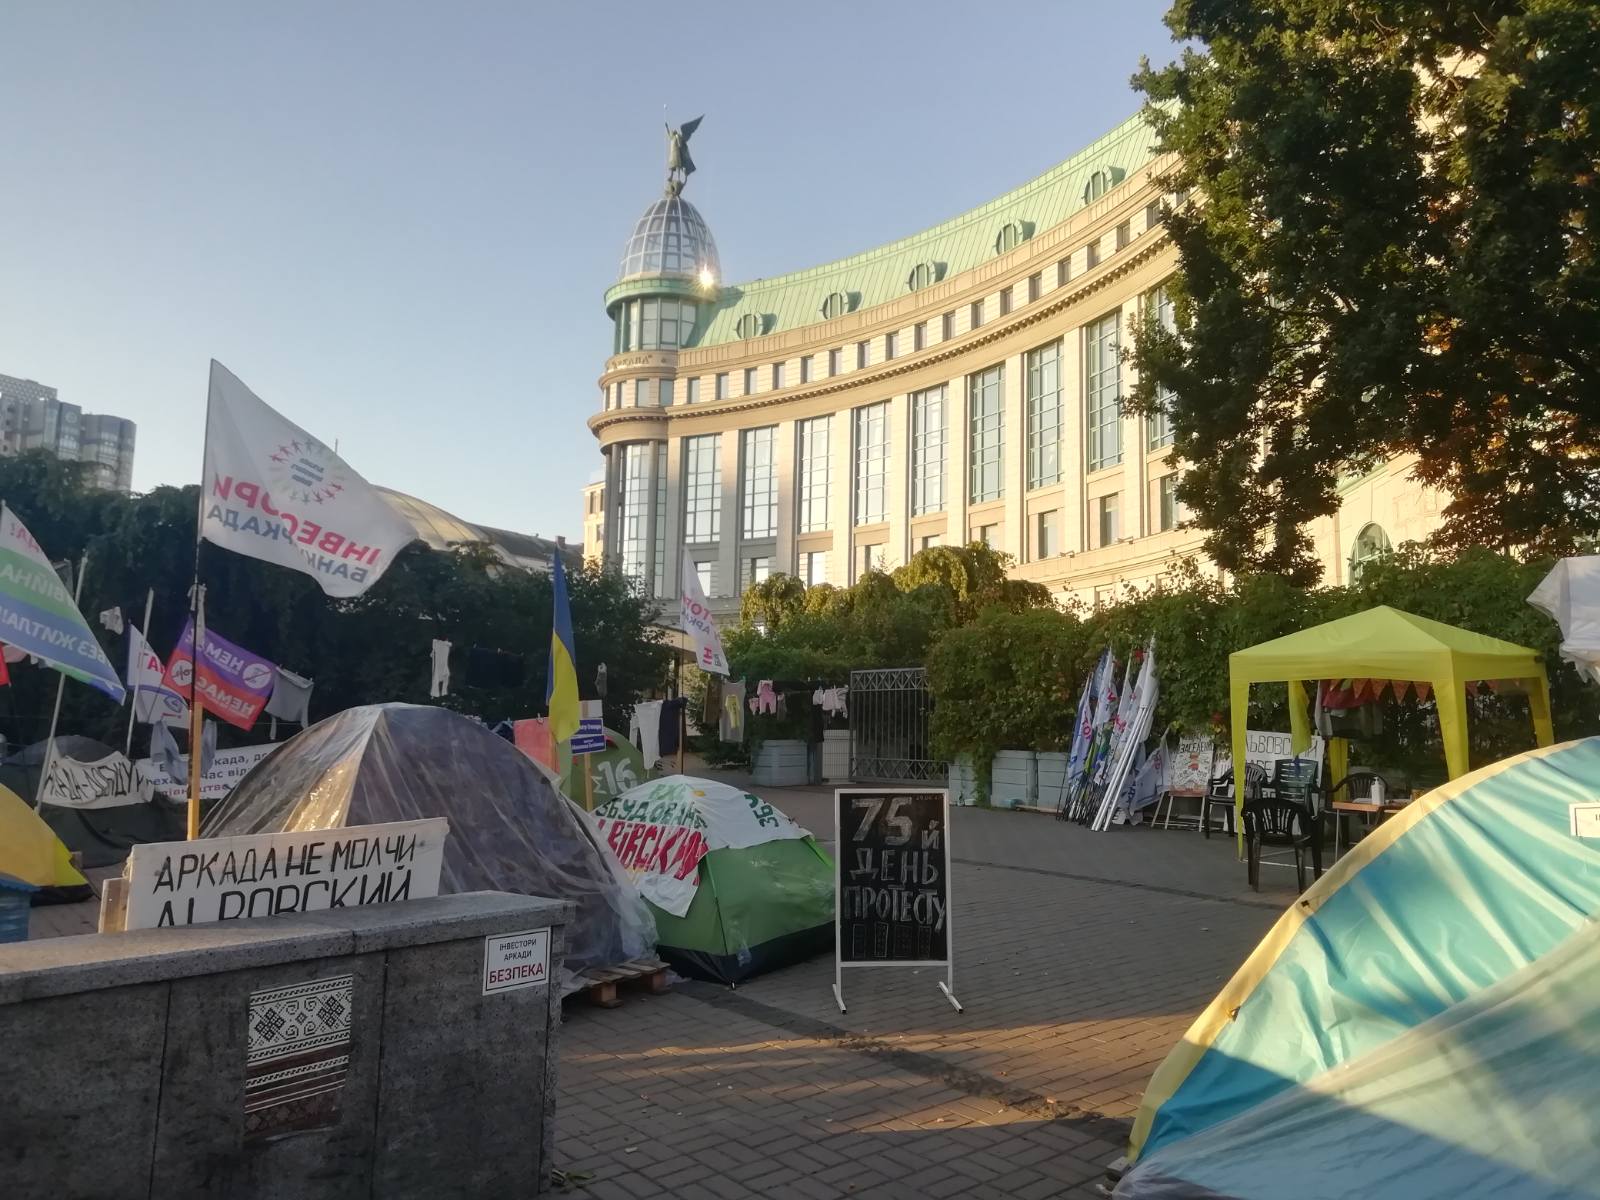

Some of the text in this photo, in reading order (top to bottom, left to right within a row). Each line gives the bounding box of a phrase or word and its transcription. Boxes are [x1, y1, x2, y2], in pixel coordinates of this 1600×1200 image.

[851, 796, 913, 846] 75
[153, 834, 416, 894] АРКАДА НЕ МОЛЧИ
[850, 847, 939, 885] ДЕНЬ
[842, 884, 946, 932] ПРОТЕСТУ
[499, 938, 537, 951] ІНВЕСТОРИ
[503, 949, 532, 961] АРКАДИ
[489, 962, 544, 984] БЕЗПЕКА
